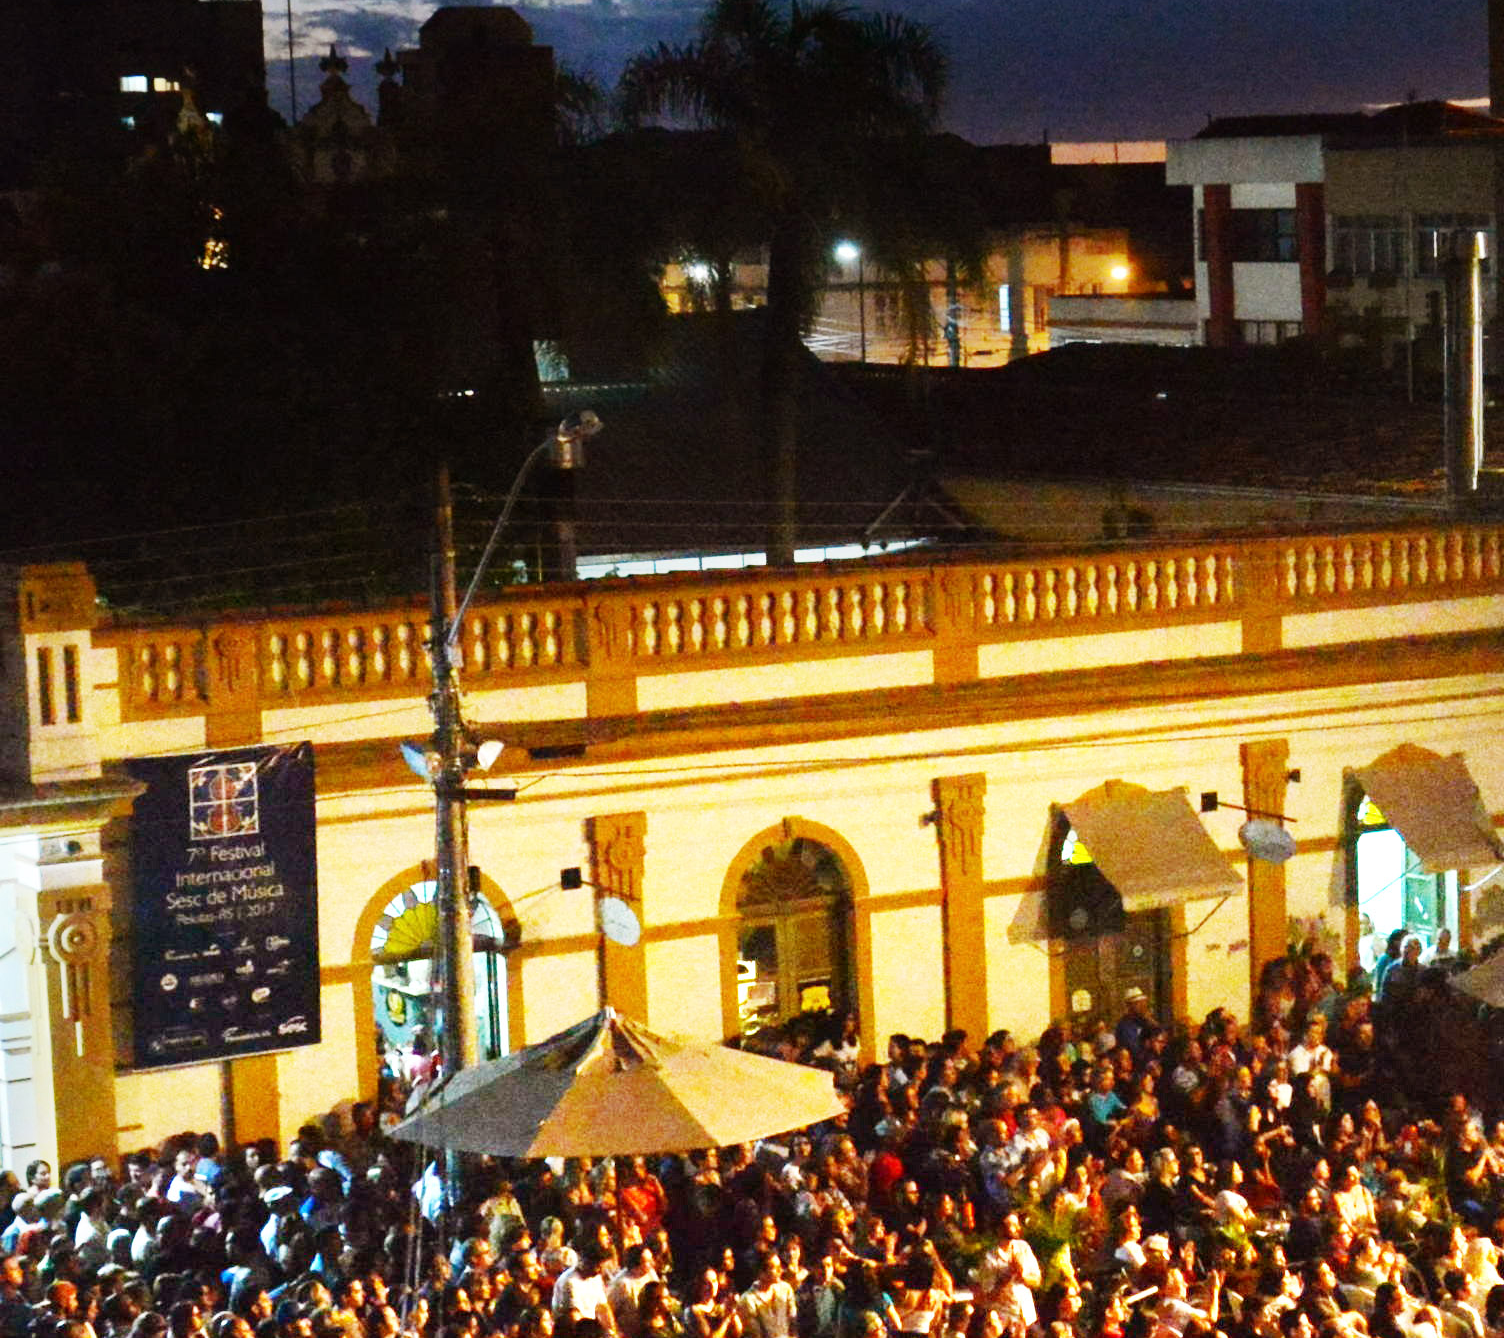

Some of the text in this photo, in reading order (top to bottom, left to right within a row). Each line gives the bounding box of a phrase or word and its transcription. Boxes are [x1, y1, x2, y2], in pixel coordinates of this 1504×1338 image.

[209, 841, 266, 862] Festival
[175, 861, 275, 888] Internacional
[165, 883, 284, 910] Sesc de Música
